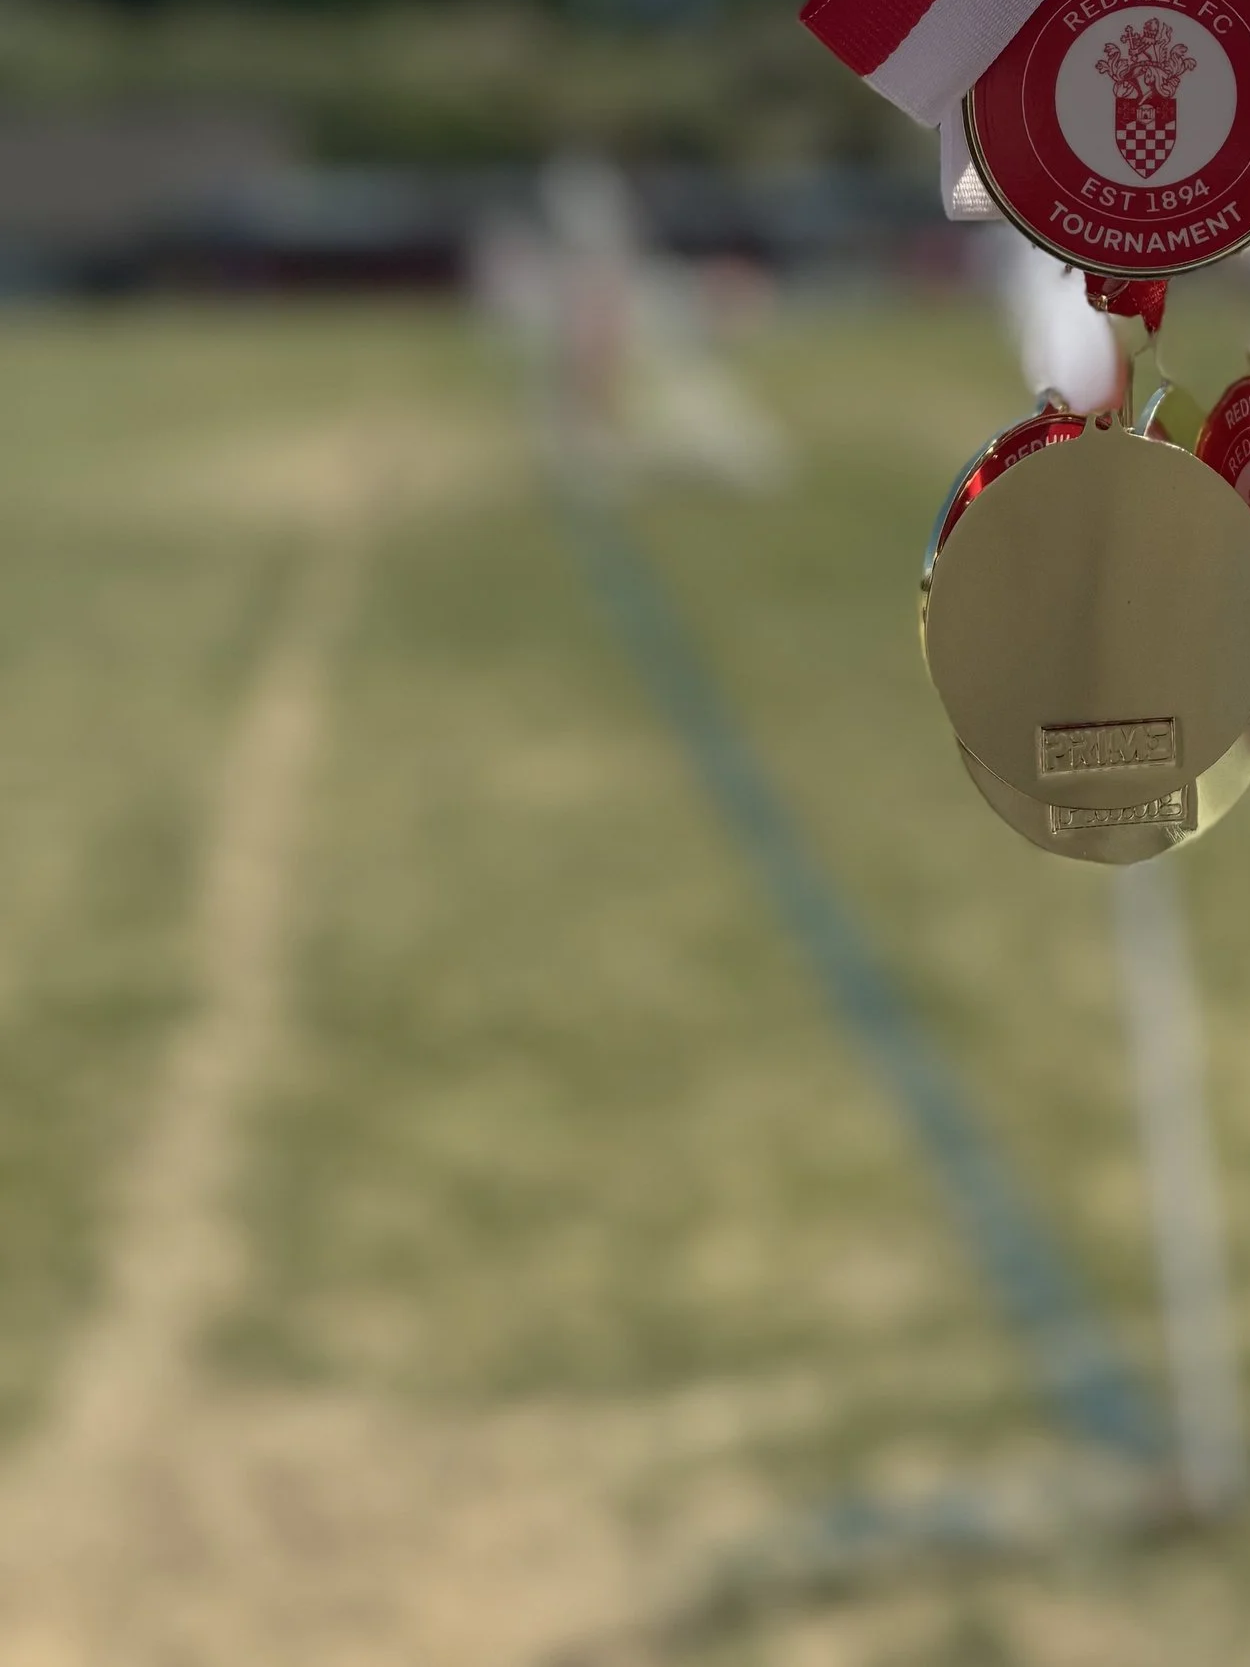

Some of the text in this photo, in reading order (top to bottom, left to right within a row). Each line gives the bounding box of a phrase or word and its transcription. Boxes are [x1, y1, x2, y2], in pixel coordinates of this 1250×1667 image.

[1197, 0, 1233, 34] FC
[1080, 177, 1210, 212] EST 1894
[1049, 200, 1242, 254] TOURNAMENT
